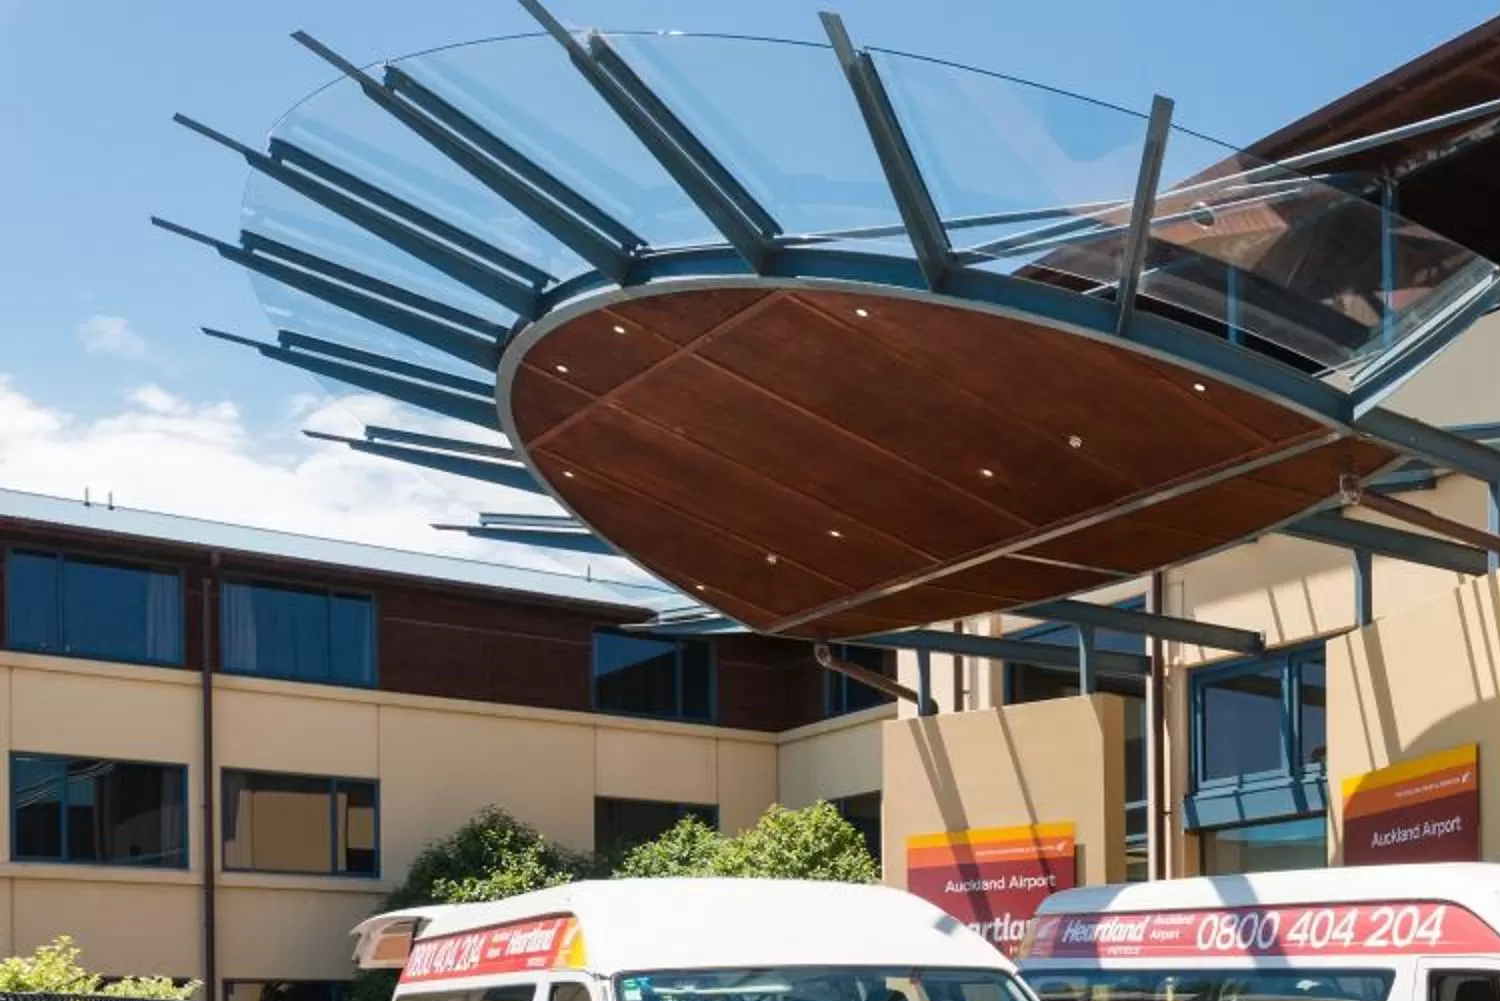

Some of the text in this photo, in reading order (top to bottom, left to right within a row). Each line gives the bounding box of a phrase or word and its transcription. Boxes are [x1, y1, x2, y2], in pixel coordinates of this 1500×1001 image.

[1371, 815, 1462, 848] Auckland Airport
[945, 874, 1056, 893] Auckland Airport
[1061, 914, 1149, 943] Heartland
[1196, 904, 1447, 950] 0800 404 204
